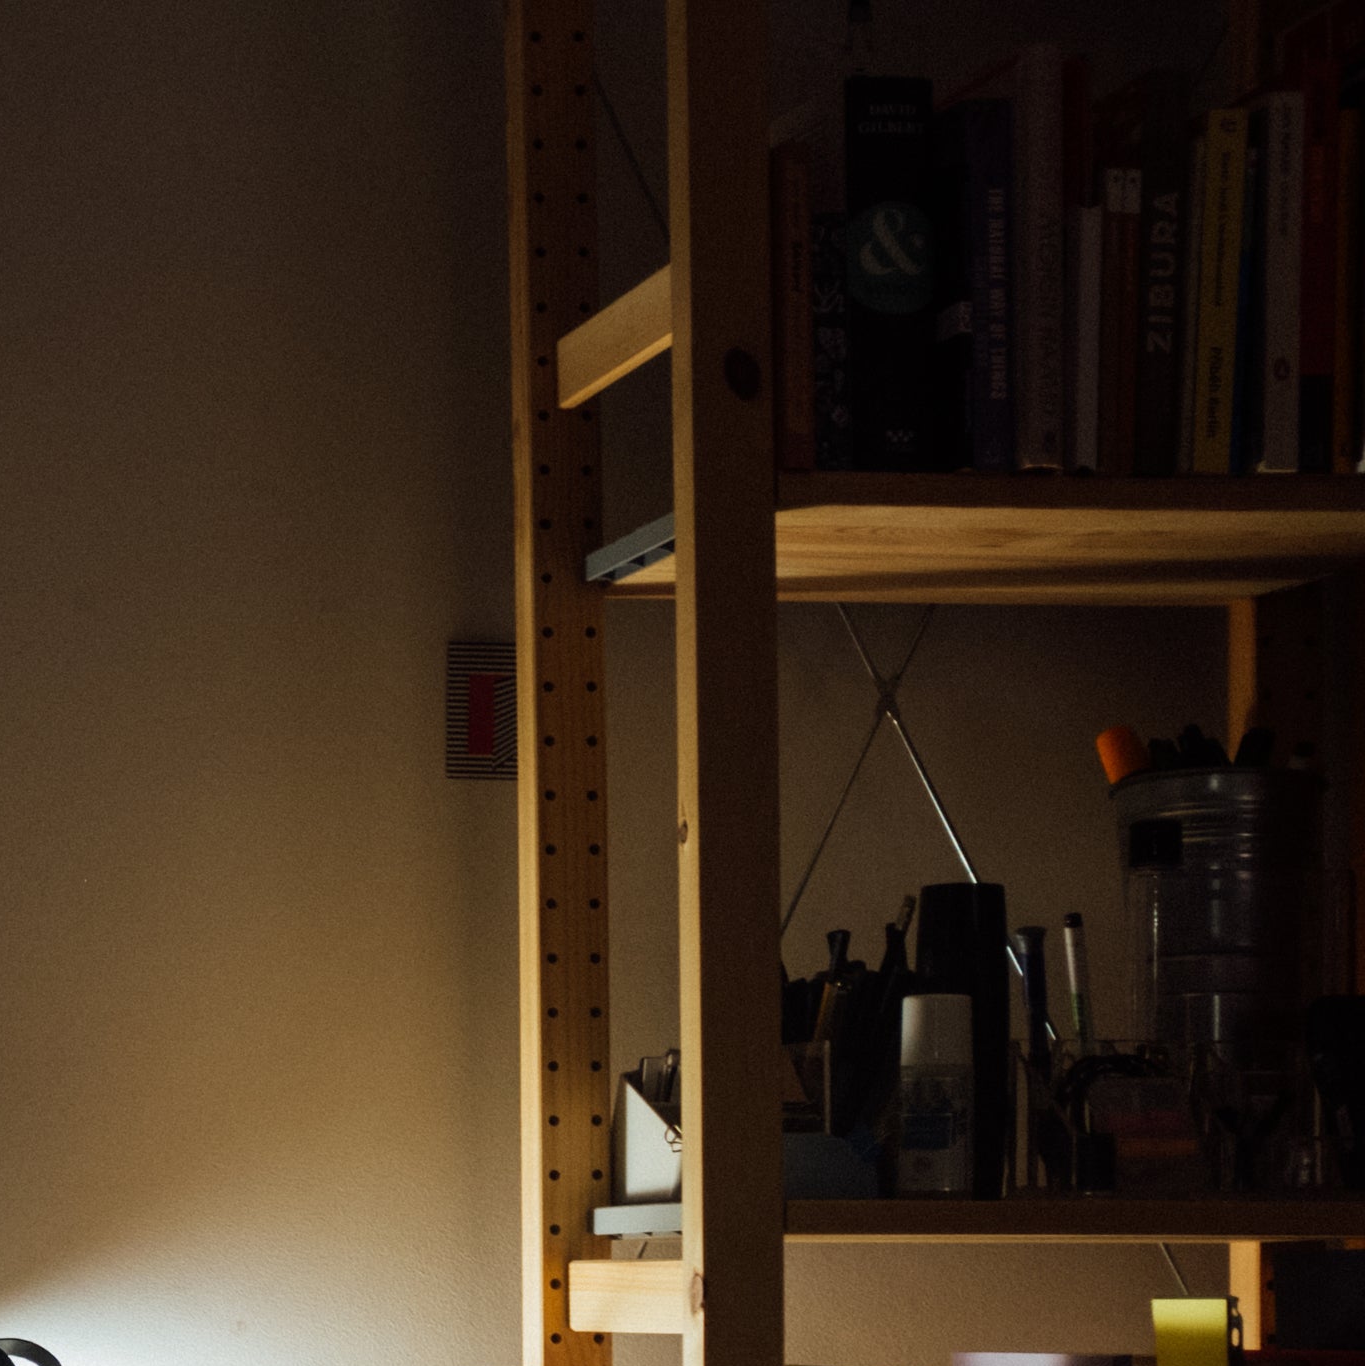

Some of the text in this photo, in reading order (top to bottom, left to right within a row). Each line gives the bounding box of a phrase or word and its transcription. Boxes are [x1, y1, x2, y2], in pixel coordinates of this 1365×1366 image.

[988, 188, 1005, 212] THE
[858, 207, 925, 277] &
[1146, 192, 1180, 354] ZIBURA
[990, 347, 1008, 400] THINGS
